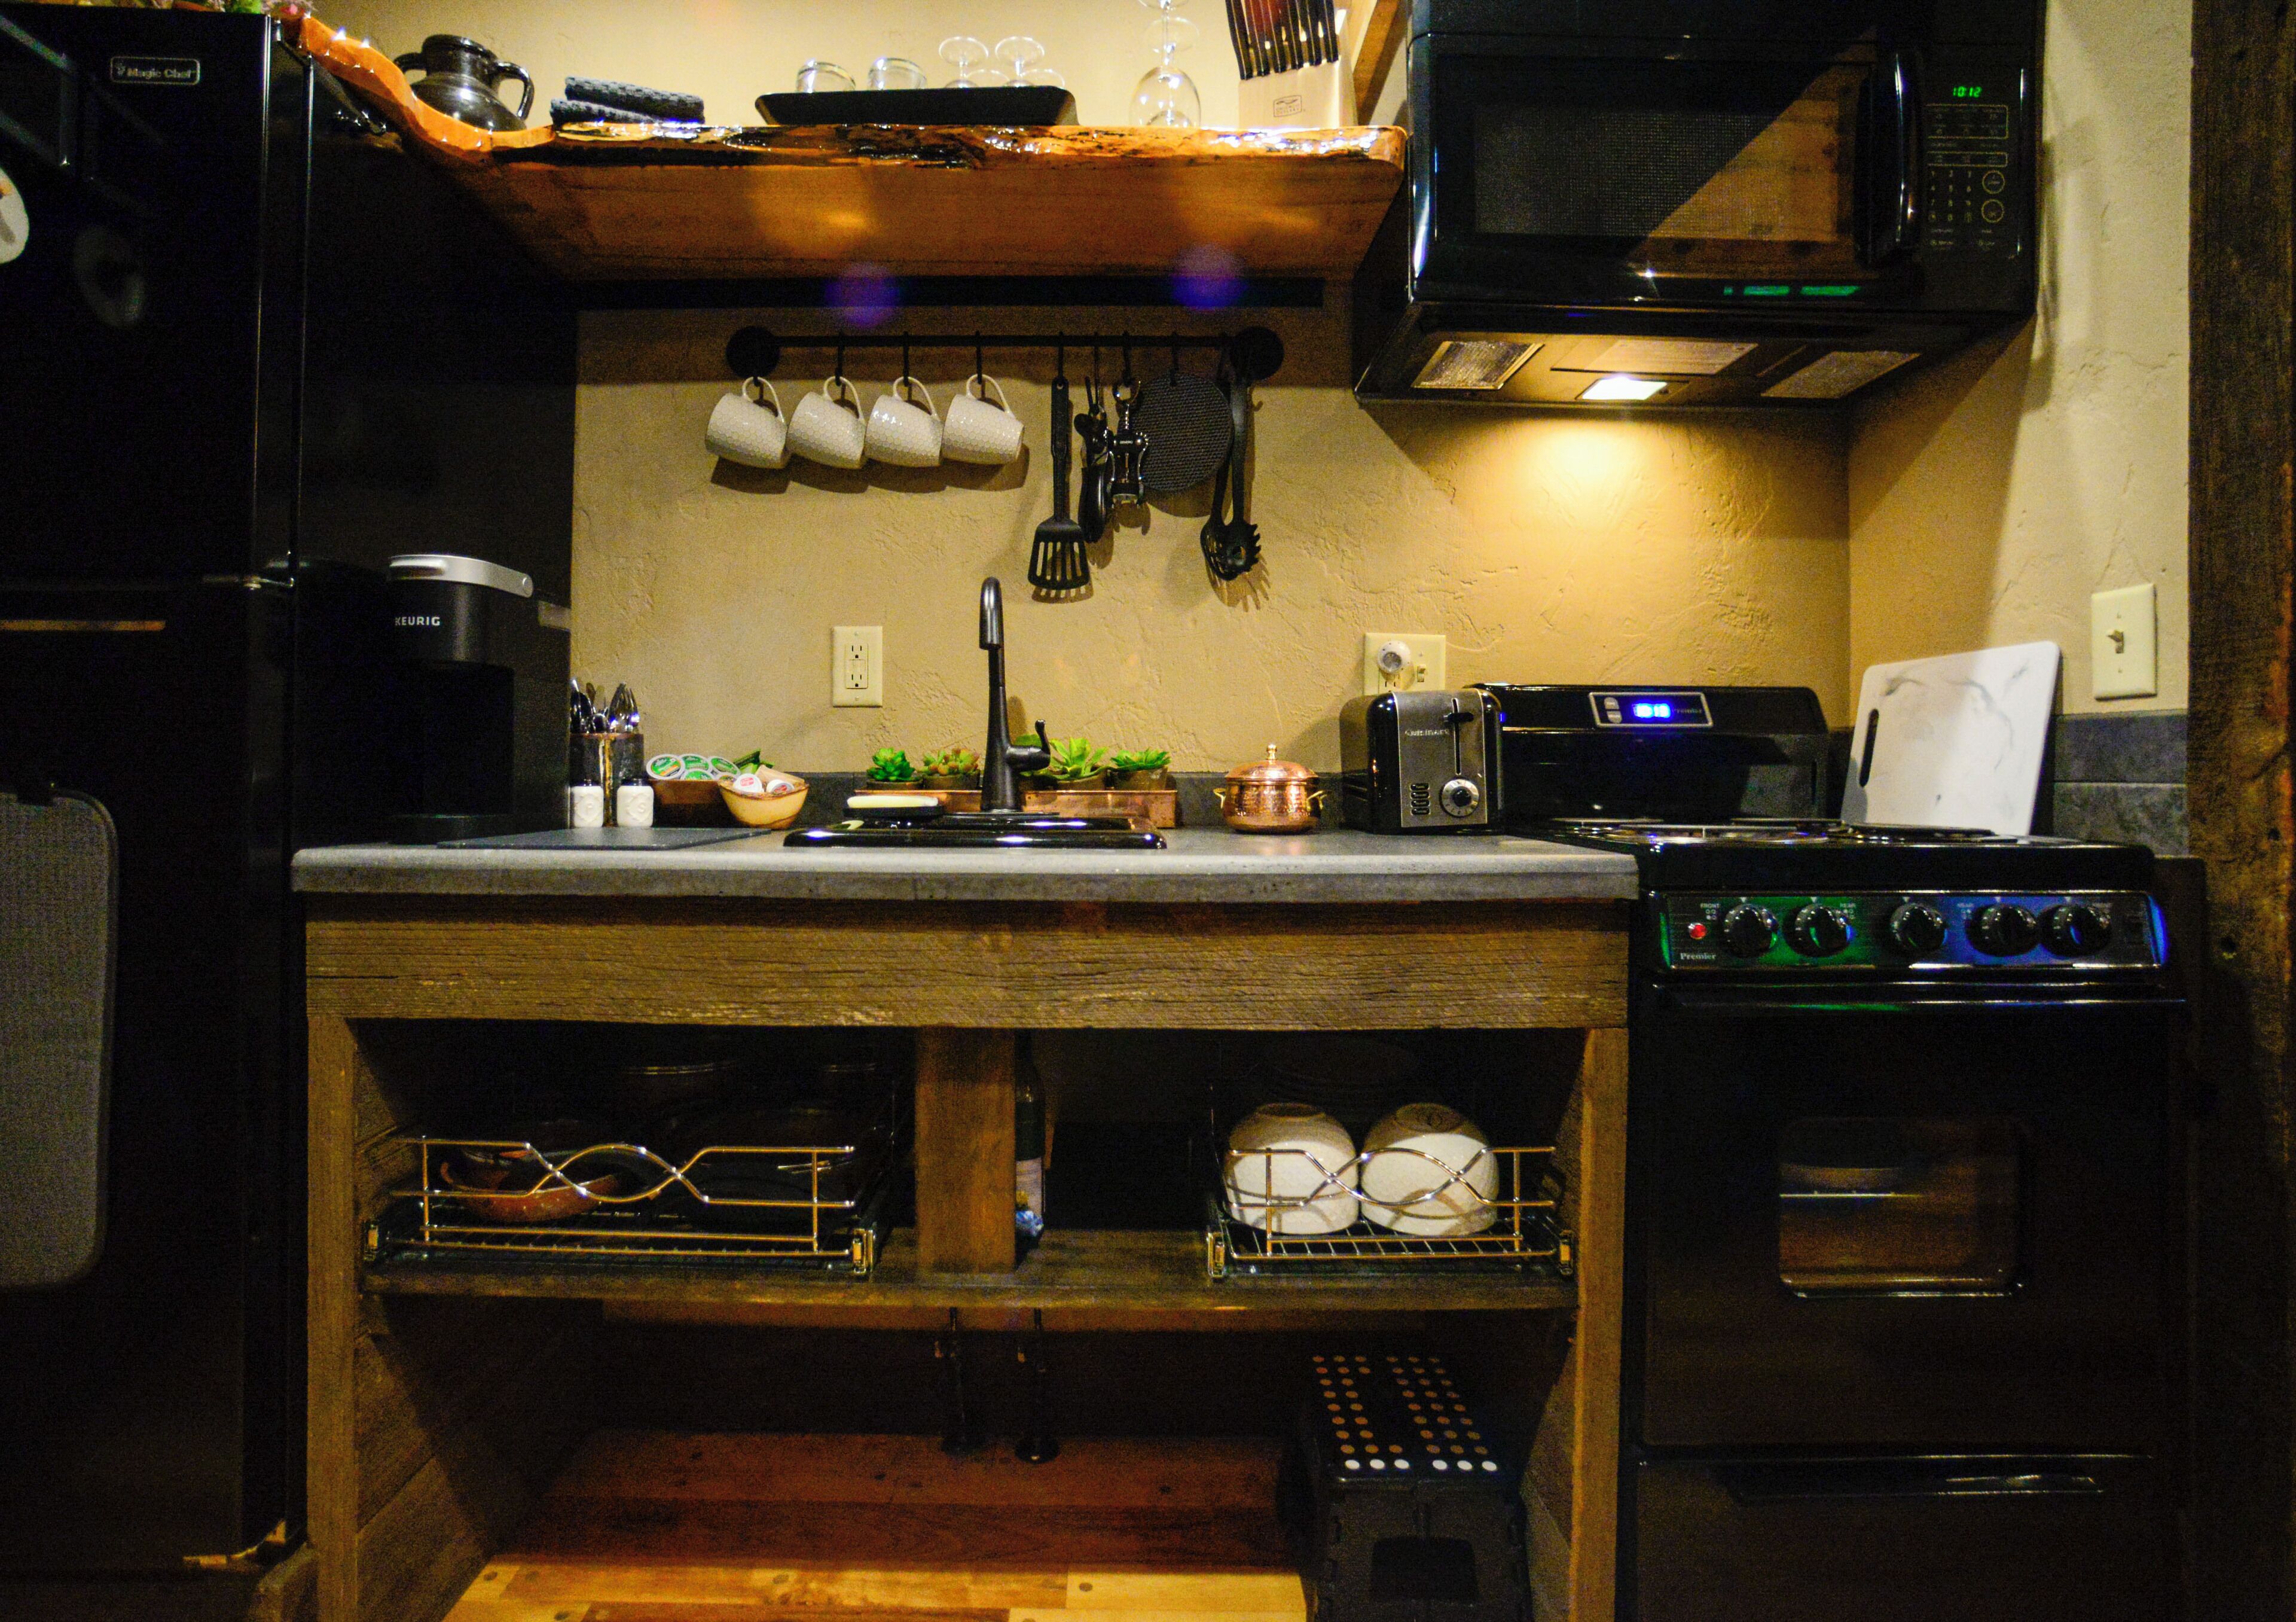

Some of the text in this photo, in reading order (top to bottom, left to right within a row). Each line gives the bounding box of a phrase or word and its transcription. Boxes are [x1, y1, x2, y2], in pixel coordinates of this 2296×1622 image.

[127, 68, 191, 80] Magic Chef
[395, 616, 441, 626] KEURIG
[637, 803, 646, 813] S
